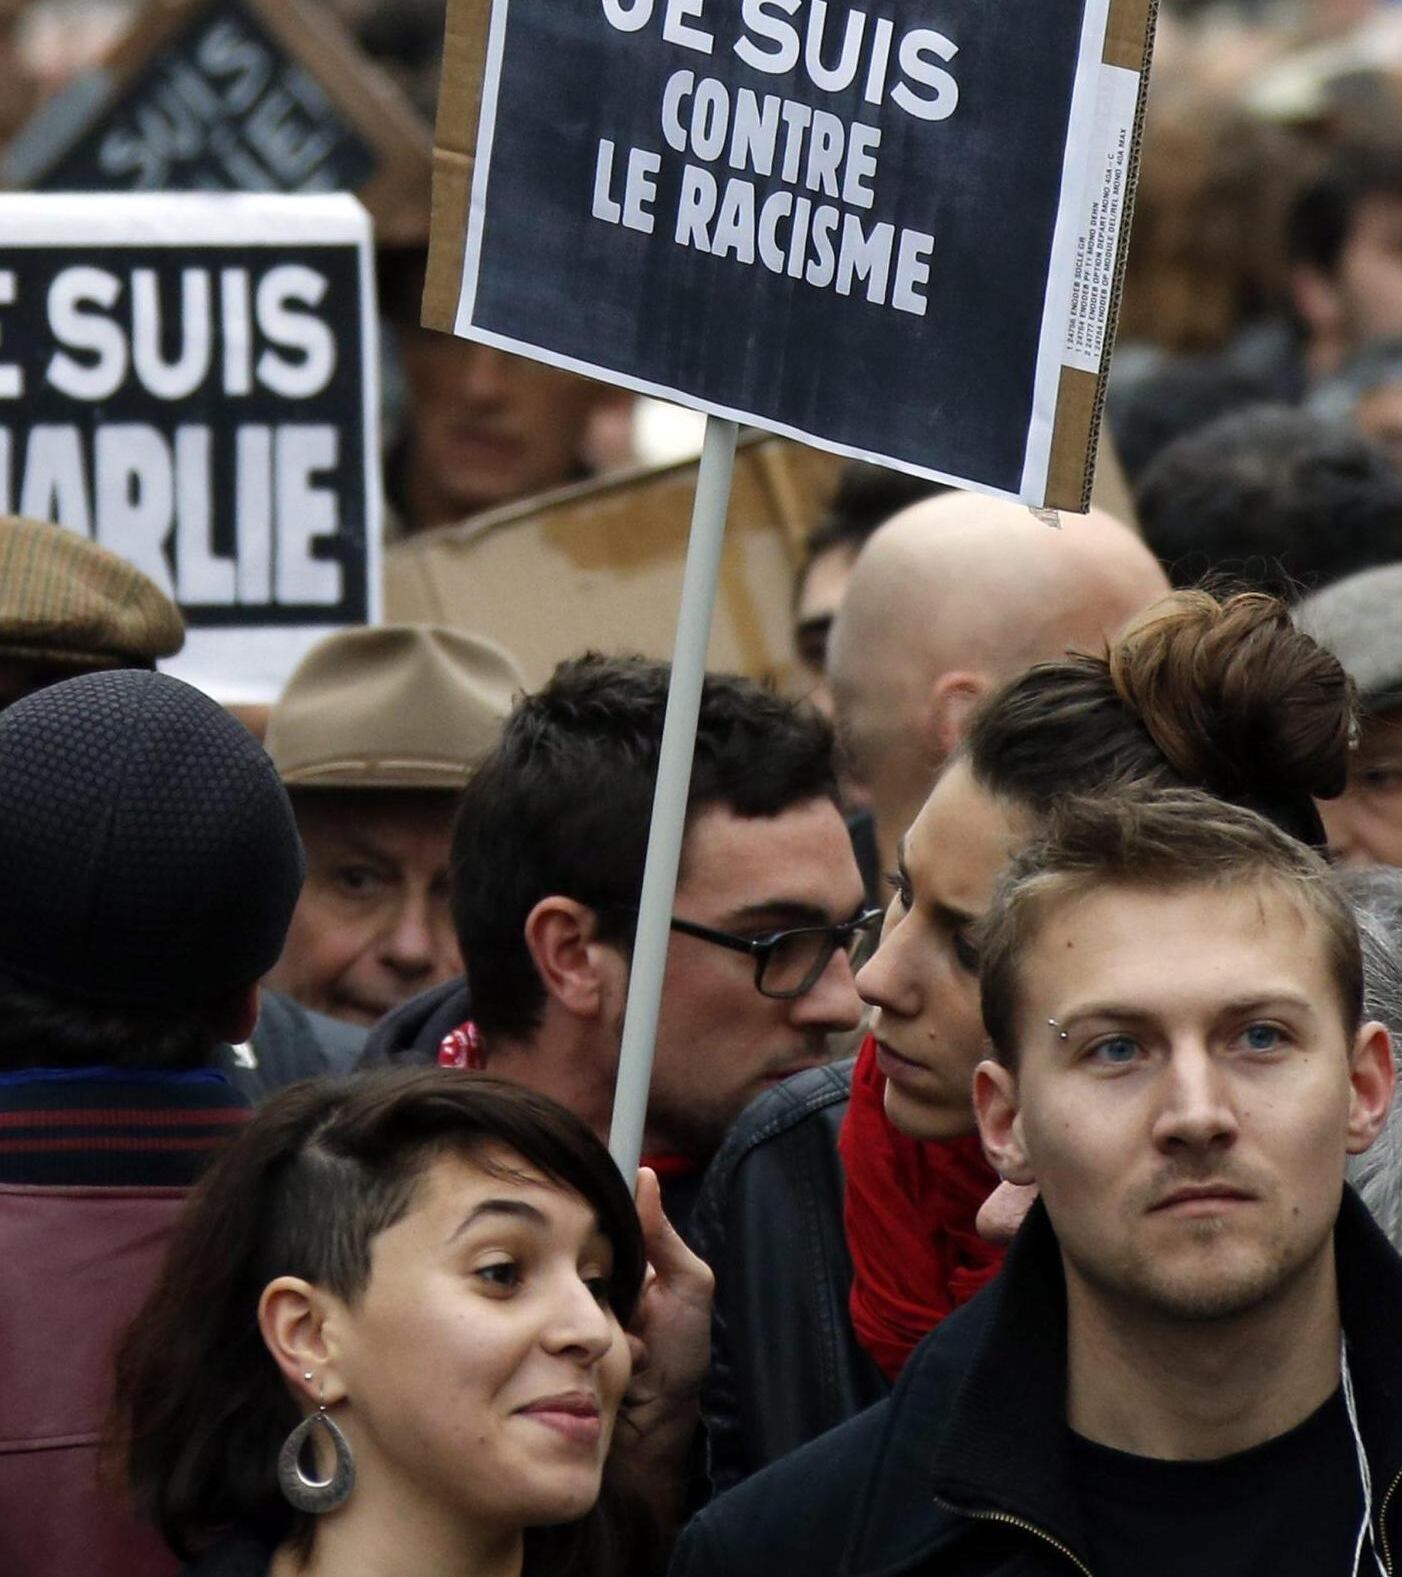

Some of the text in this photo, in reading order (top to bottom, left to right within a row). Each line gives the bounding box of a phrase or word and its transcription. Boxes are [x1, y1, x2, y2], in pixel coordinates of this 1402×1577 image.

[733, 0, 959, 121] SUIS
[661, 69, 882, 209] CONTRE
[1112, 169, 1121, 194] MONO
[591, 138, 935, 316] LE RACISME
[1075, 252, 1083, 278] SOCLE
[1087, 228, 1095, 254] MONO
[1092, 252, 1102, 284] OPTION
[1101, 187, 1109, 213] MONO
[46, 265, 337, 400] SUIS
[0, 422, 342, 607] ARLIE
